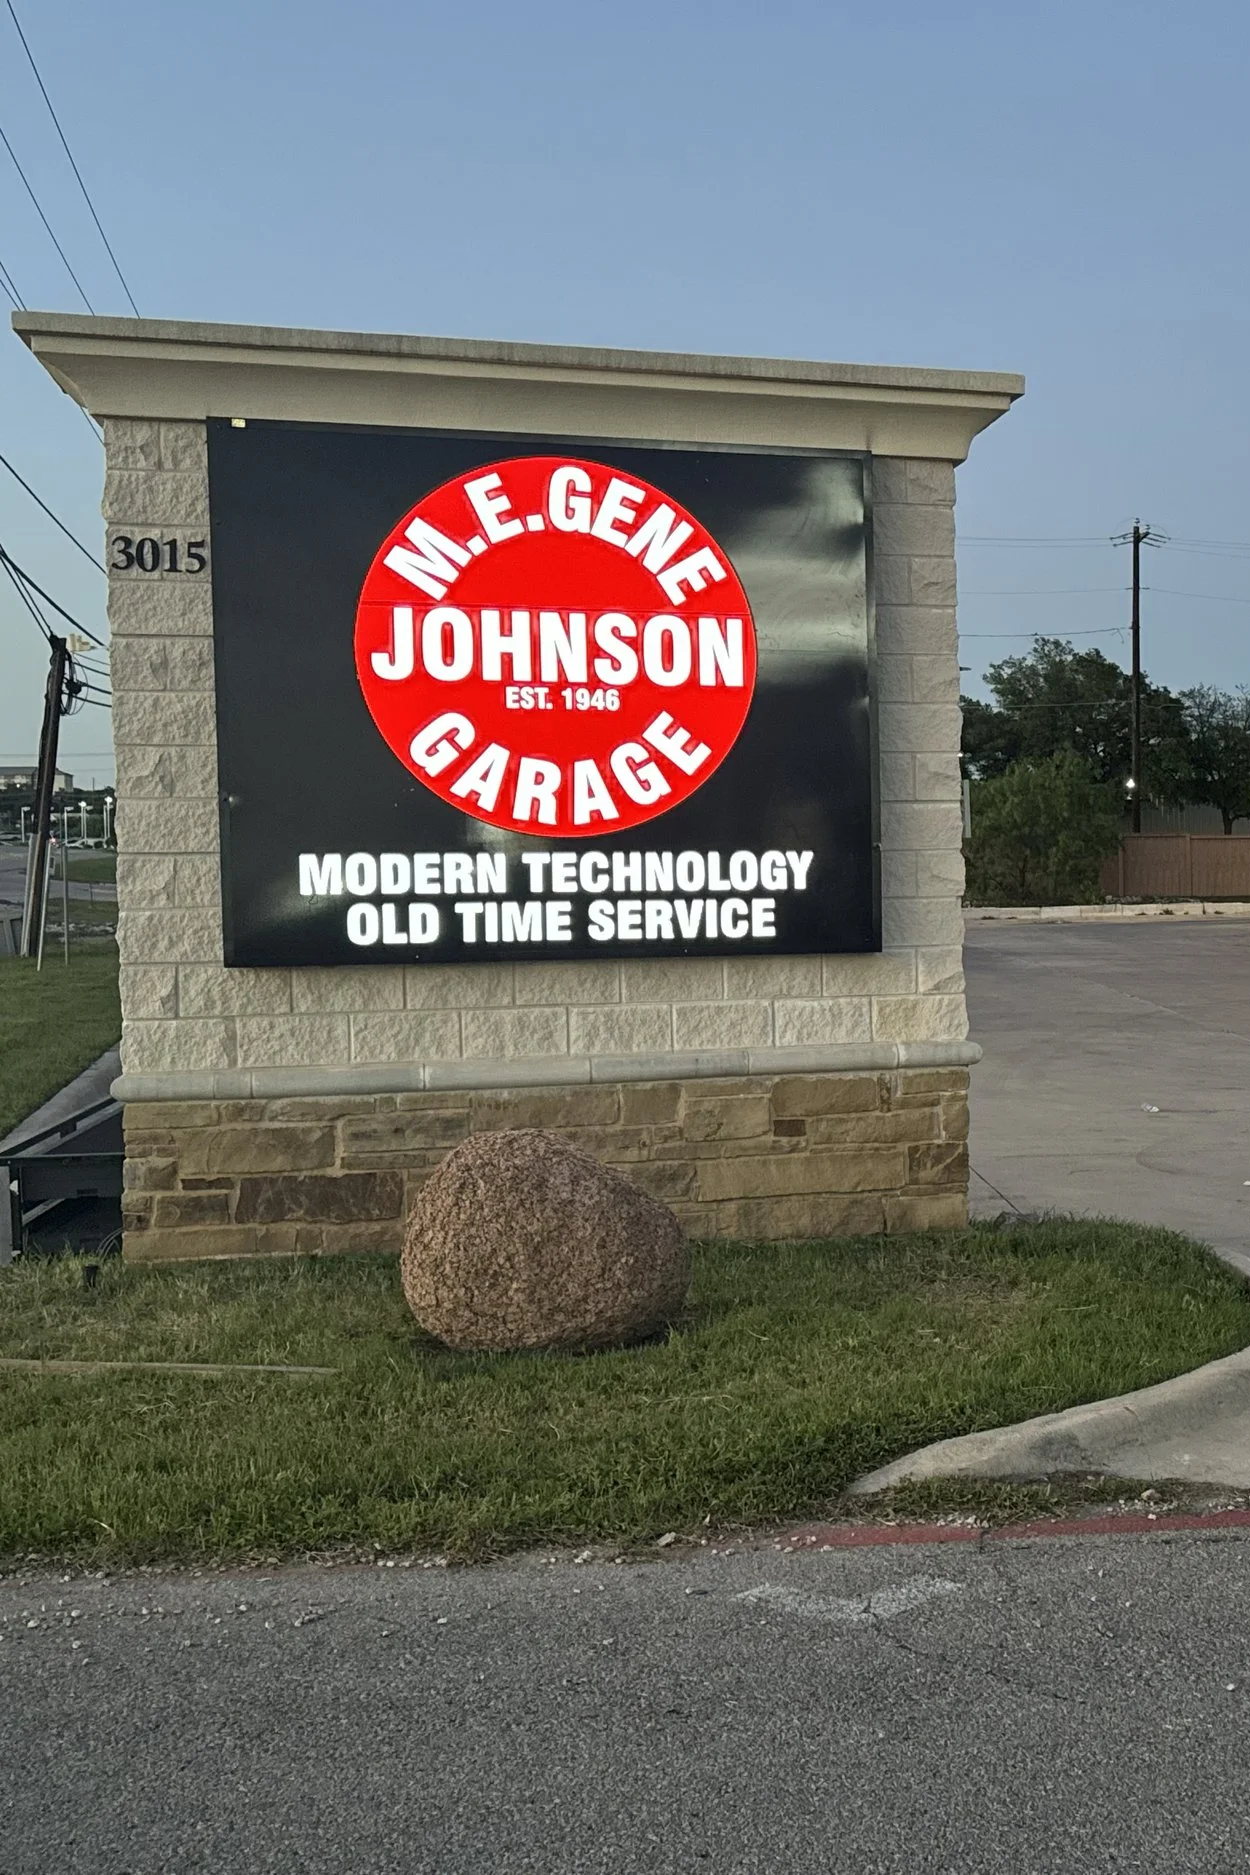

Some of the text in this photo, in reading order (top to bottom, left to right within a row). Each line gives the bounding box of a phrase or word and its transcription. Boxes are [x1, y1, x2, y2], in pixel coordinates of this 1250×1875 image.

[110, 535, 206, 574] 3015
[548, 466, 726, 606] GENE
[371, 607, 745, 688] JOHNSON
[505, 686, 622, 712] EST. 1946
[409, 711, 712, 826] GARAGE
[298, 849, 815, 896] MODERN TECHNOLOGY
[346, 898, 777, 946] OLD TIME SERVICE
